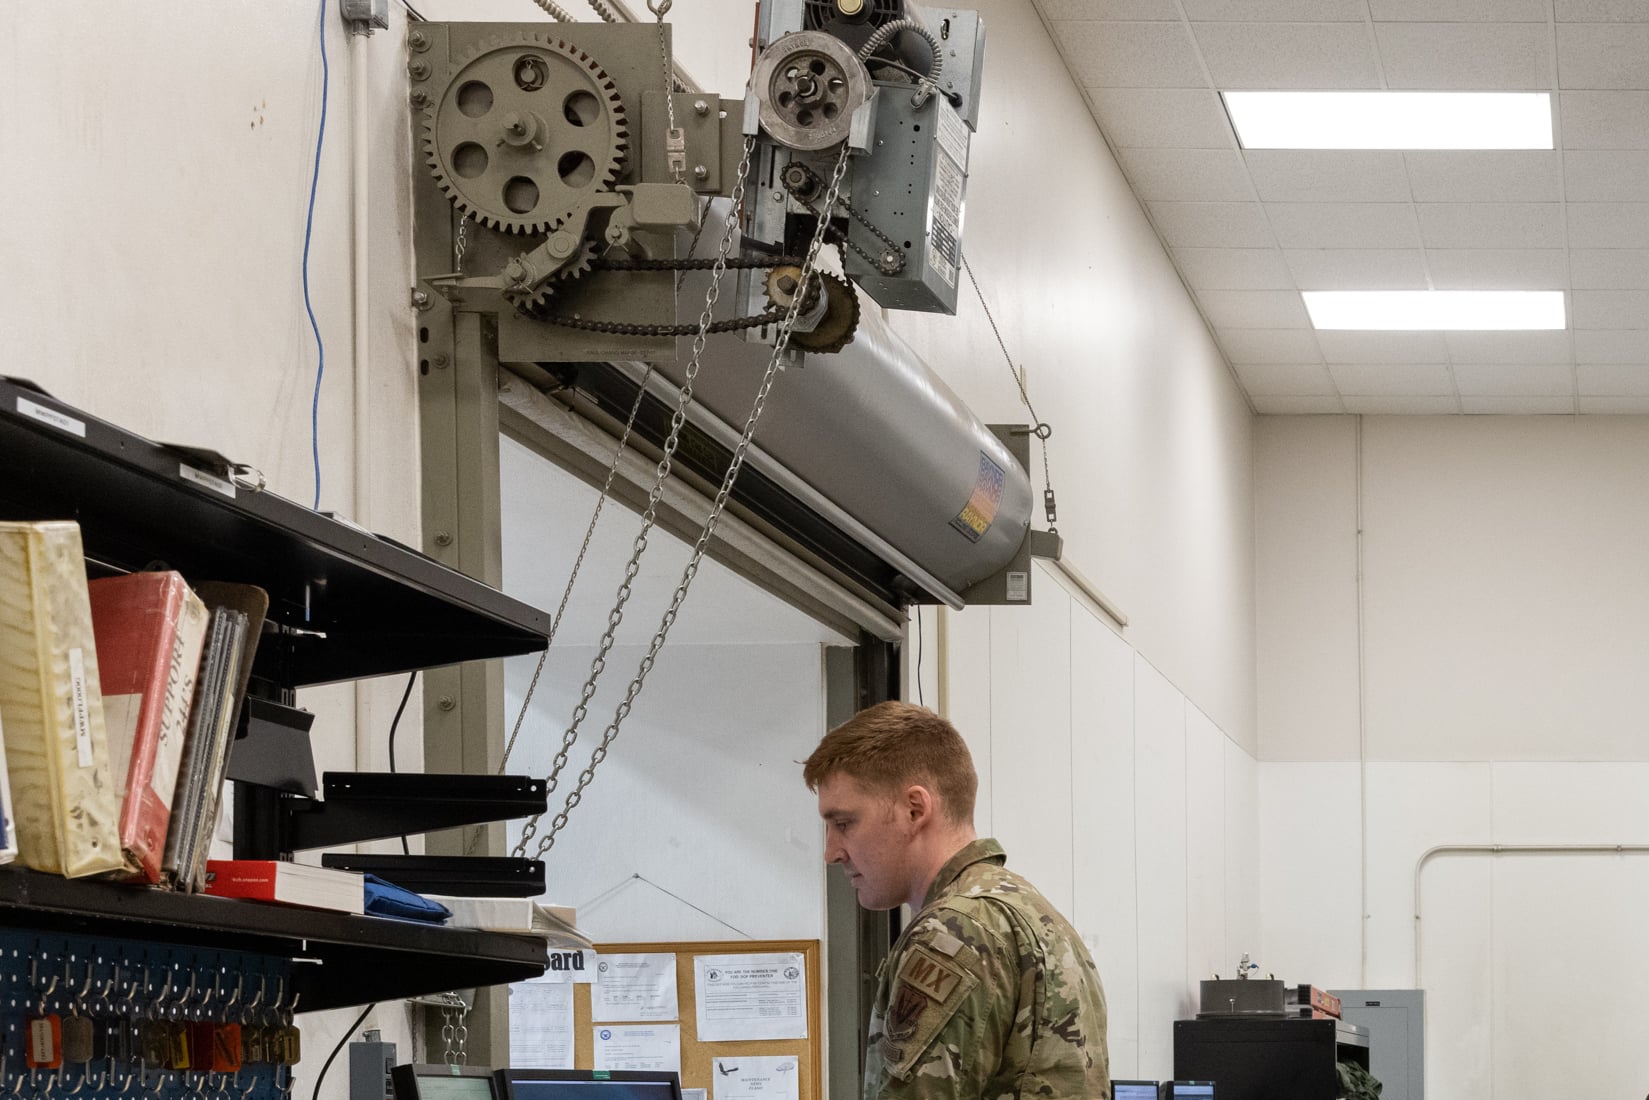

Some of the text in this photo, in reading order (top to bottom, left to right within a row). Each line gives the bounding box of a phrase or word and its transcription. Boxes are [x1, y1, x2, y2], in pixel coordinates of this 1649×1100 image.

[160, 631, 184, 747] SUPPORT
[544, 951, 585, 971] ard
[909, 956, 951, 994] MX
